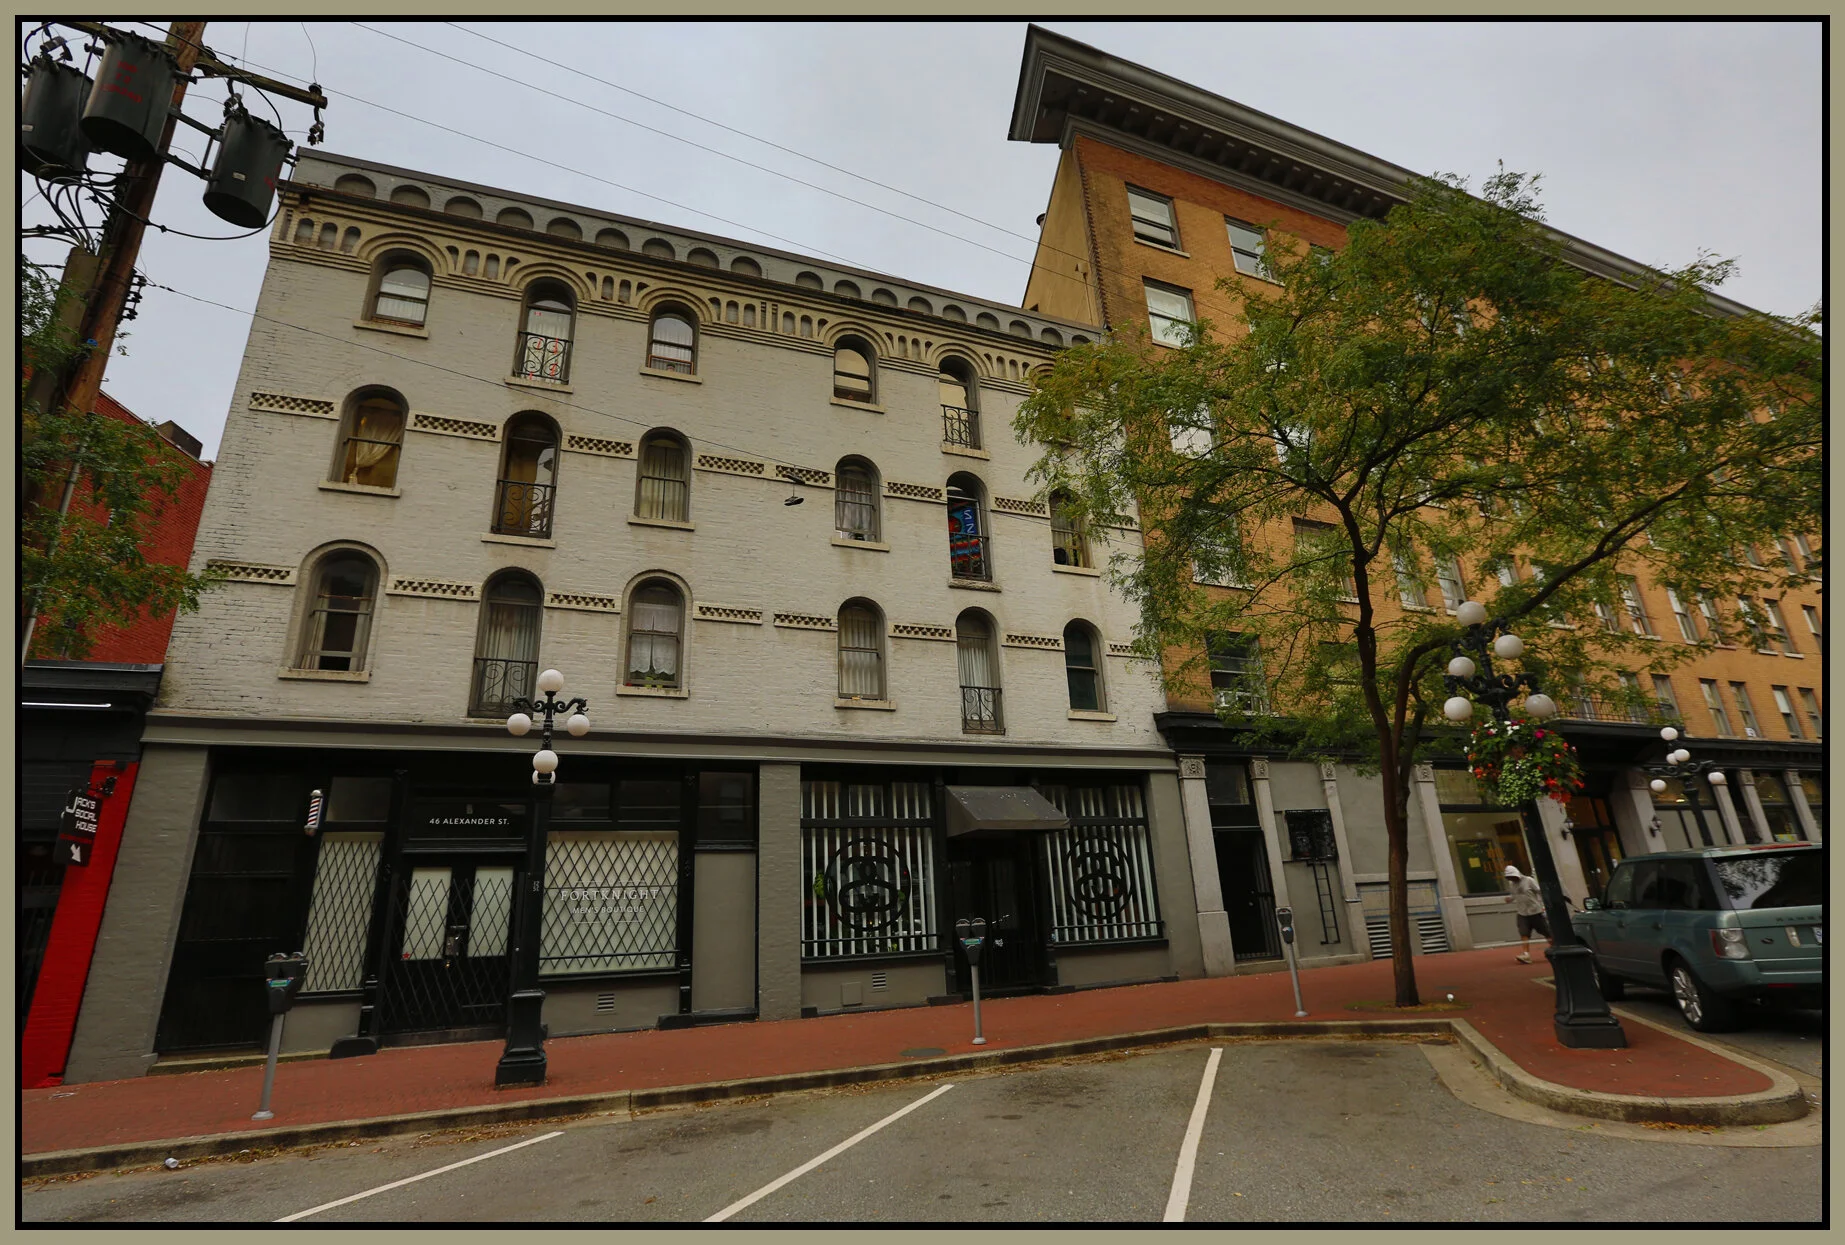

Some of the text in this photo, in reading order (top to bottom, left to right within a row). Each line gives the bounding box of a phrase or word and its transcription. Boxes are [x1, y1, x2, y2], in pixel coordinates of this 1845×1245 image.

[65, 796, 96, 813] JACK'S
[75, 821, 98, 832] HOUSE
[561, 889, 659, 901] FORTKNIGHT
